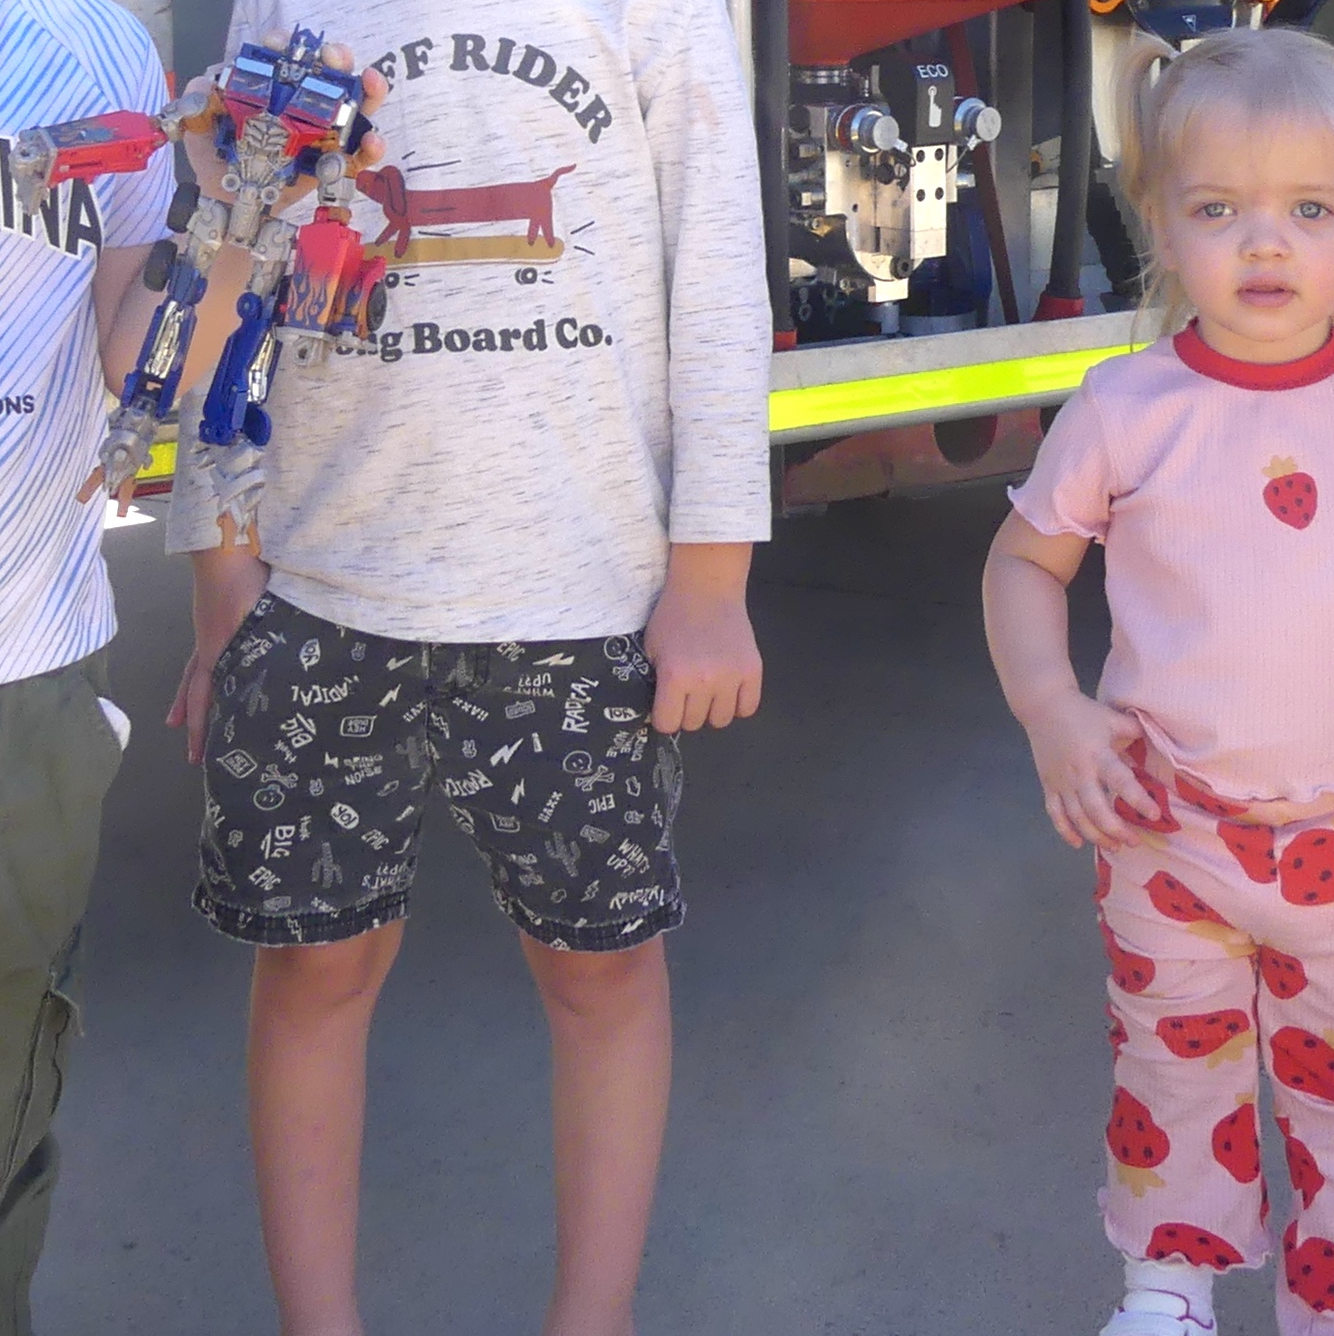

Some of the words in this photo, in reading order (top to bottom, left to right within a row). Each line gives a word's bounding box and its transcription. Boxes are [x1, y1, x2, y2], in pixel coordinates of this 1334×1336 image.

[916, 63, 950, 80] ECO
[448, 33, 613, 144] RIDER
[412, 318, 549, 355] Board
[554, 316, 614, 350] Co.
[290, 675, 361, 707] ADICAL
[588, 793, 617, 815] EPIC
[248, 865, 283, 892] EPIC
